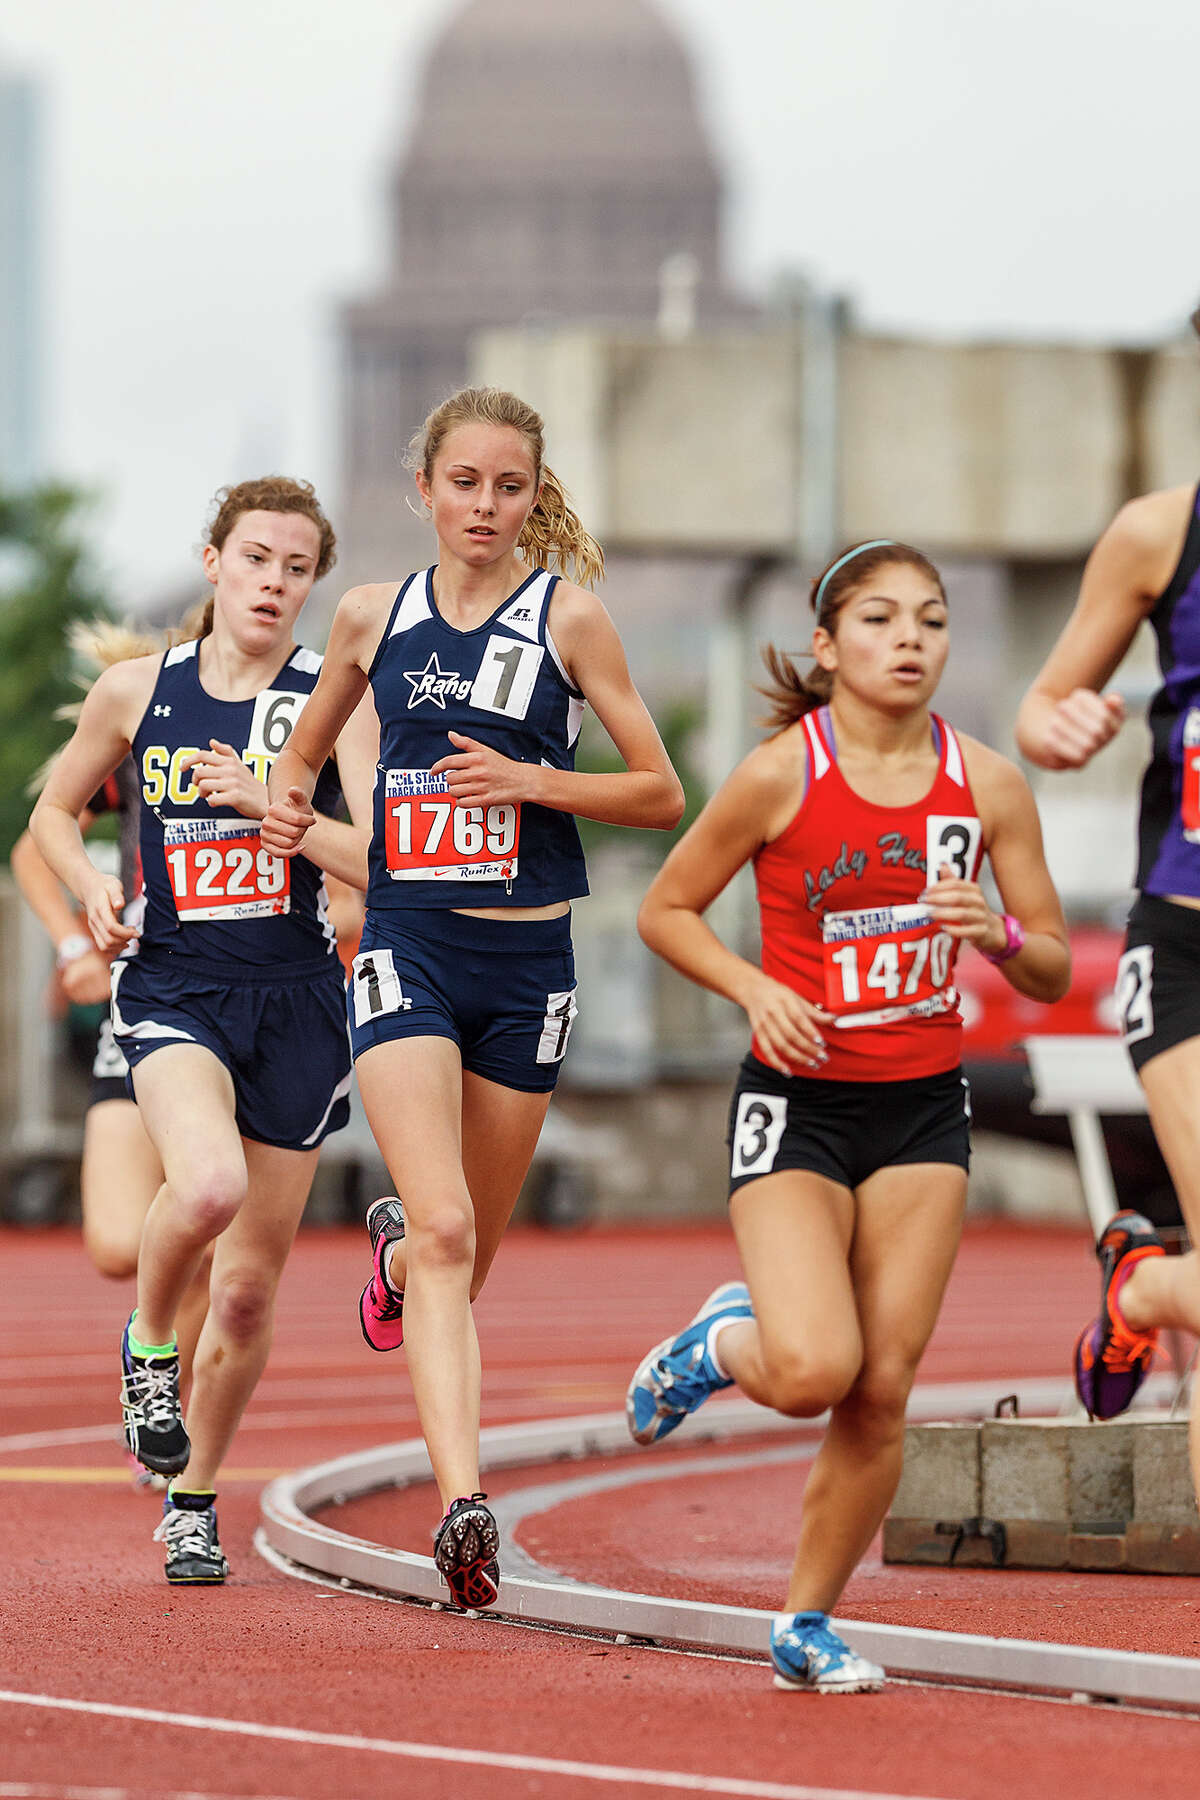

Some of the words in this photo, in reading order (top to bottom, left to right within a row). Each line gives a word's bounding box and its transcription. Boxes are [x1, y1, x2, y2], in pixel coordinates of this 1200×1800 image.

[417, 674, 475, 700] Rang
[493, 645, 524, 710] 1
[263, 696, 296, 753] 6
[387, 785, 414, 798] TRACK
[416, 786, 422, 795] &
[423, 783, 445, 795] FIELD
[415, 771, 448, 785] STATE
[187, 820, 218, 833] STATE
[391, 801, 516, 856] 1769
[936, 824, 971, 882] 3
[168, 848, 285, 898] 1229
[804, 842, 867, 912] Lady
[878, 832, 928, 873] Hu
[358, 957, 384, 1014] 1
[831, 931, 953, 1003] 1470
[1122, 961, 1144, 1034] 2
[555, 996, 572, 1059] 1
[741, 1102, 773, 1168] 3
